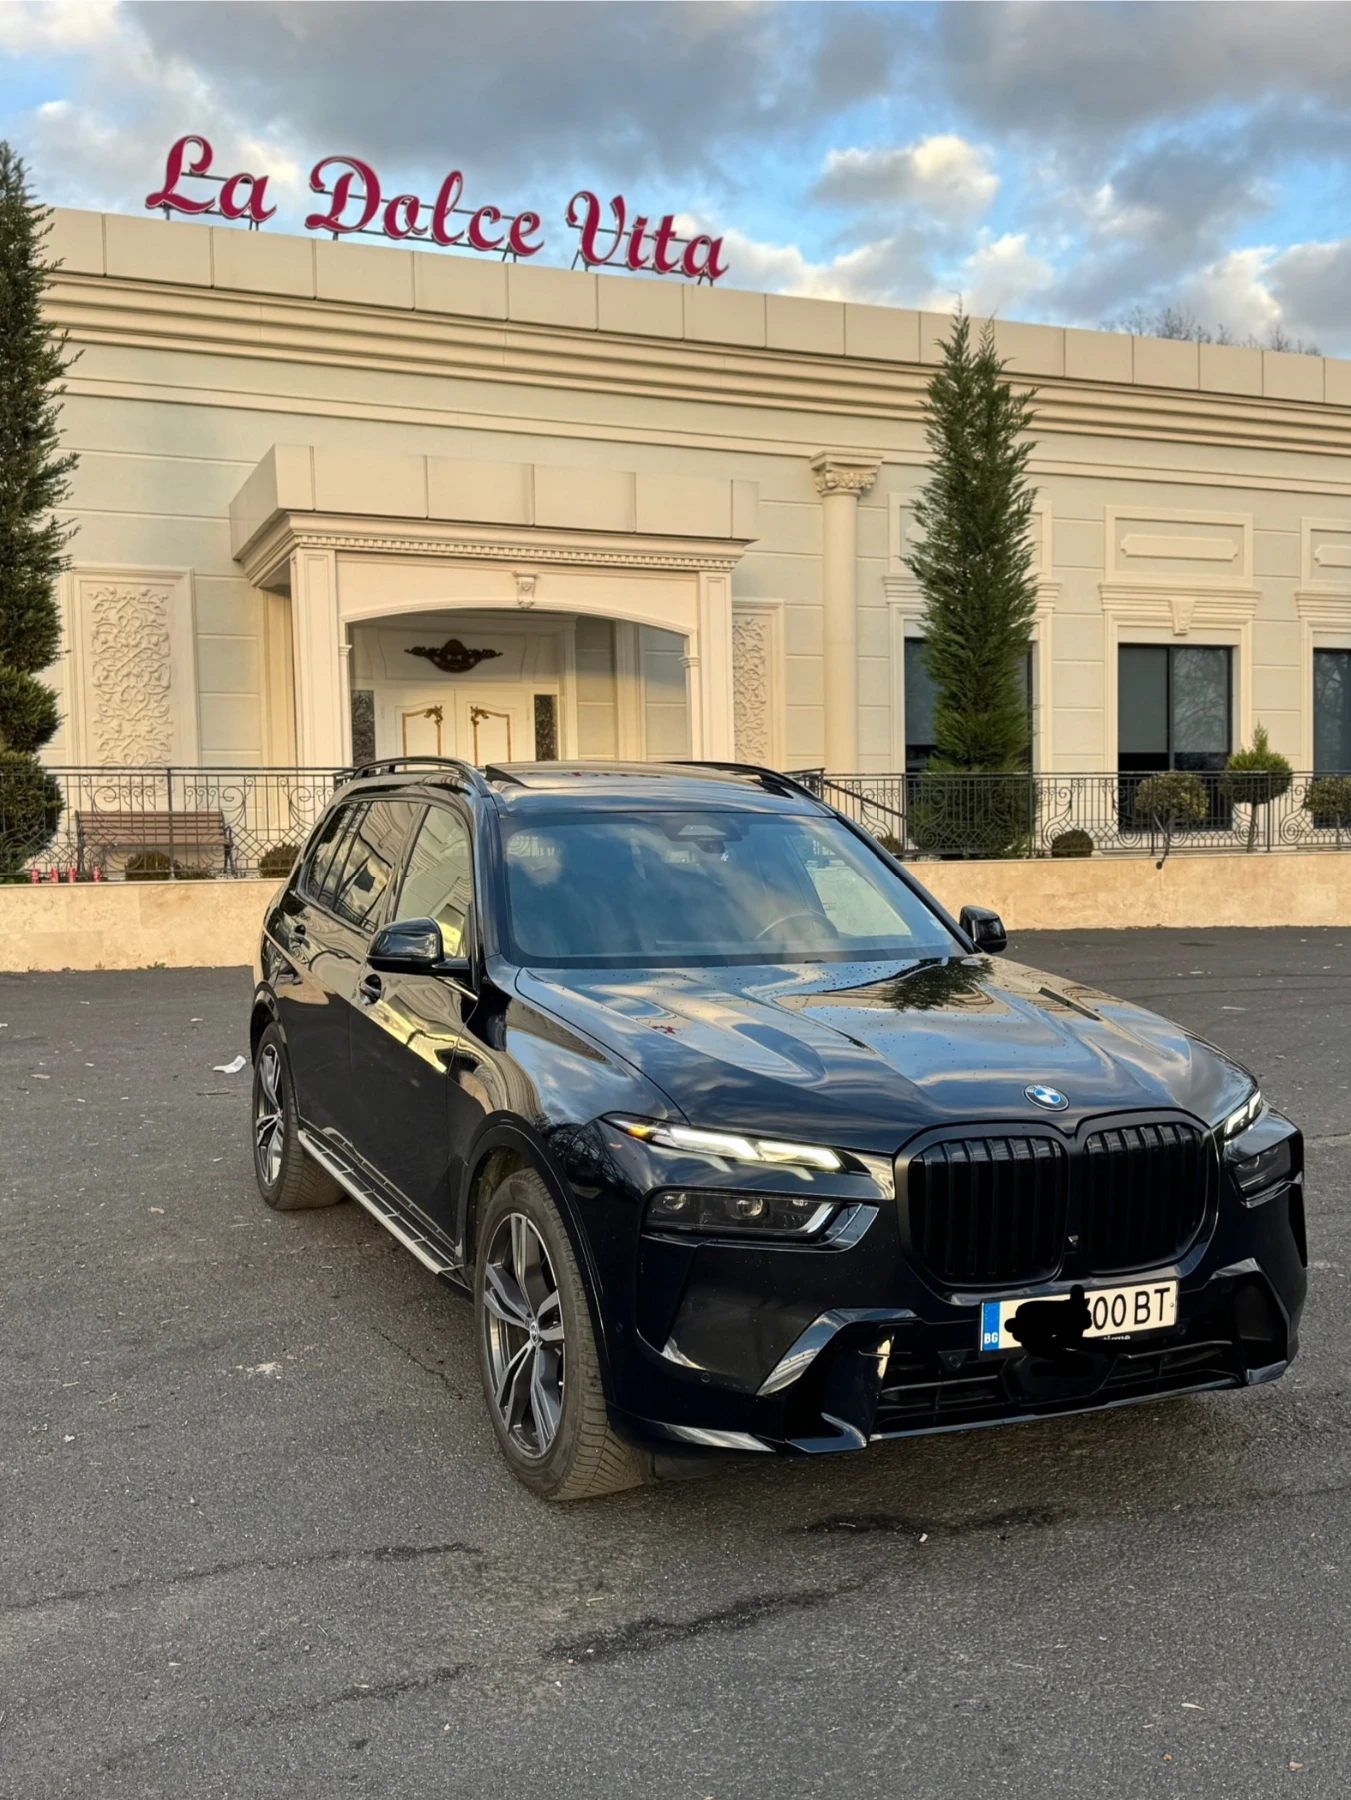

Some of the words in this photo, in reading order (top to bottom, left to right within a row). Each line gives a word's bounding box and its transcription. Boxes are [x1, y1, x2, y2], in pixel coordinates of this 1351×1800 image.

[145, 134, 277, 222] La
[305, 156, 544, 257] Dolce
[565, 190, 729, 280] Vita
[1086, 1294, 1127, 1330] 00
[1134, 1287, 1170, 1325] BT
[984, 1332, 999, 1344] BG
